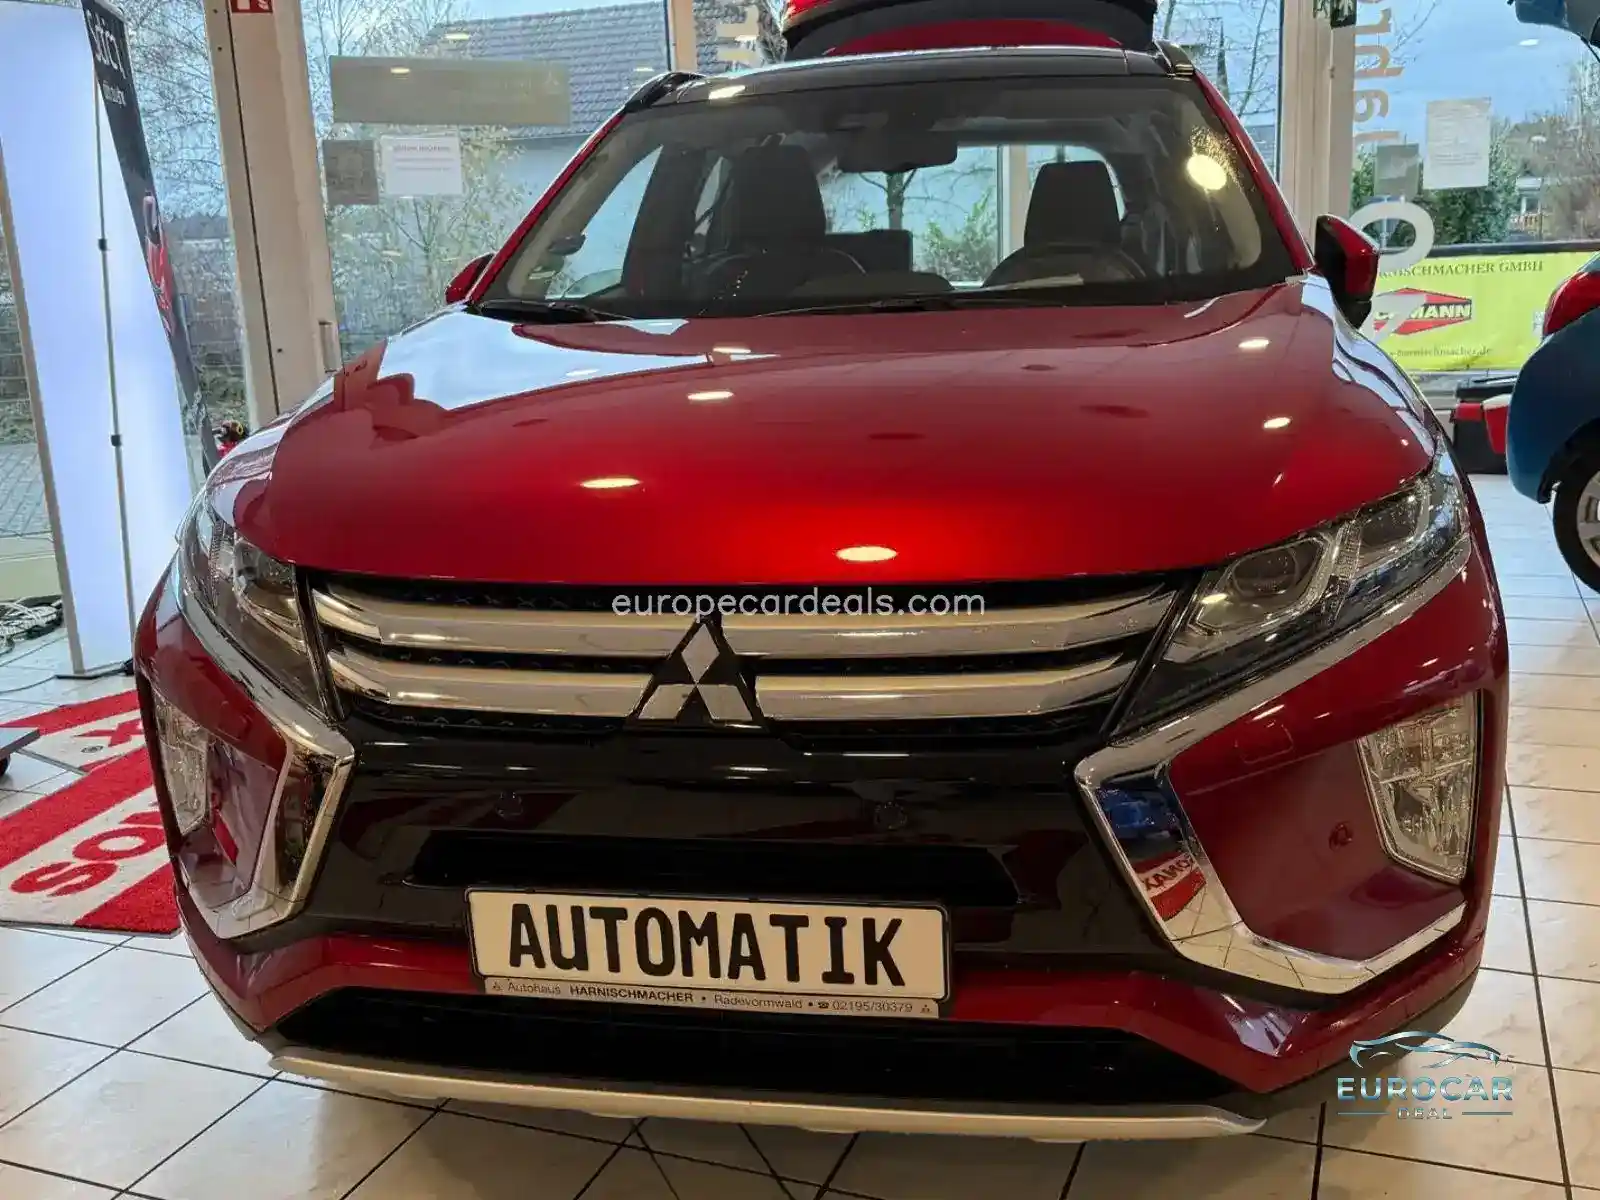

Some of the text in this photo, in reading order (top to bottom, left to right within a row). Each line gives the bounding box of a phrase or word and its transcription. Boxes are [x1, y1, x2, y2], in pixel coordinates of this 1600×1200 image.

[1499, 260, 1543, 273] GMBH
[508, 903, 906, 987] AUTOMATIK
[507, 979, 913, 1014] Autohaus HARNISCHMACHER Radevormwald 02195/30379
